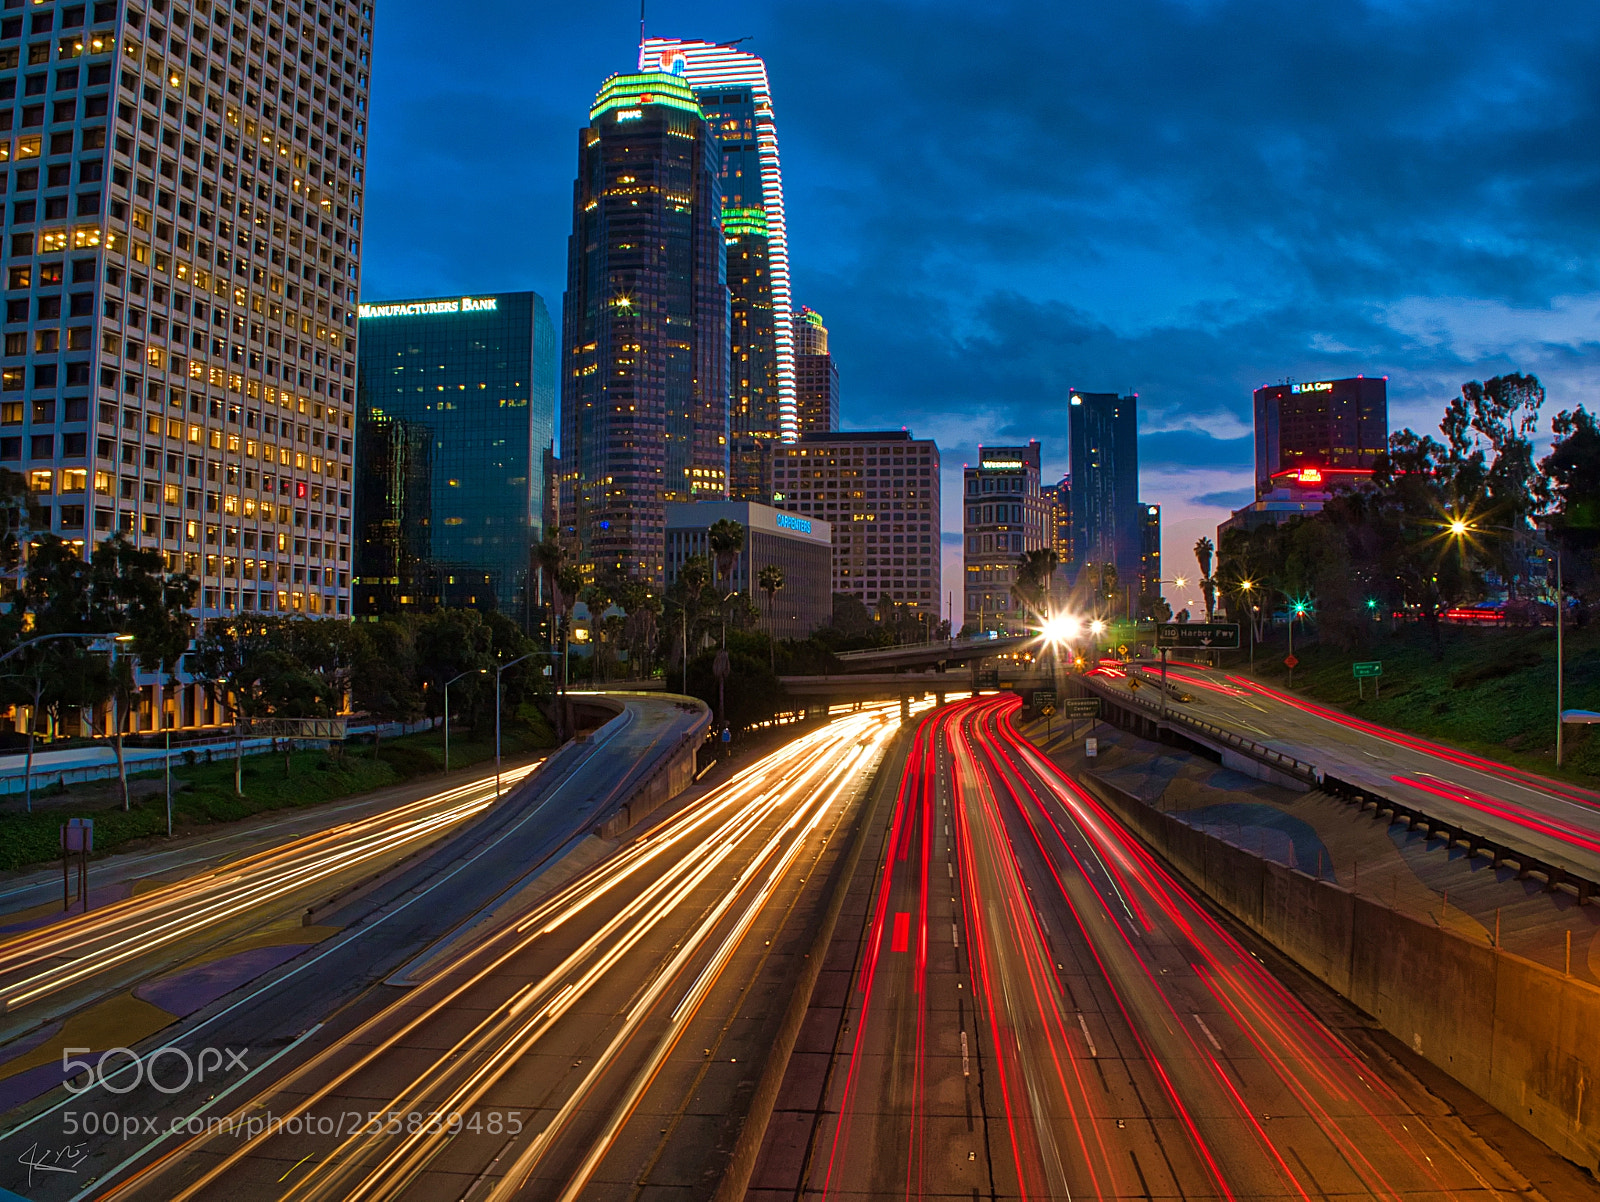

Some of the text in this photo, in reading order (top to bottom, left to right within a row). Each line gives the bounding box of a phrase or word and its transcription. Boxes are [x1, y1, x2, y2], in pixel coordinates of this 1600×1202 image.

[616, 109, 643, 122] pwc
[358, 297, 497, 317] MANUFACTURERS BANK
[776, 513, 812, 534] CARPENTERS
[1164, 629, 1234, 638] 110 Harbor Fwy
